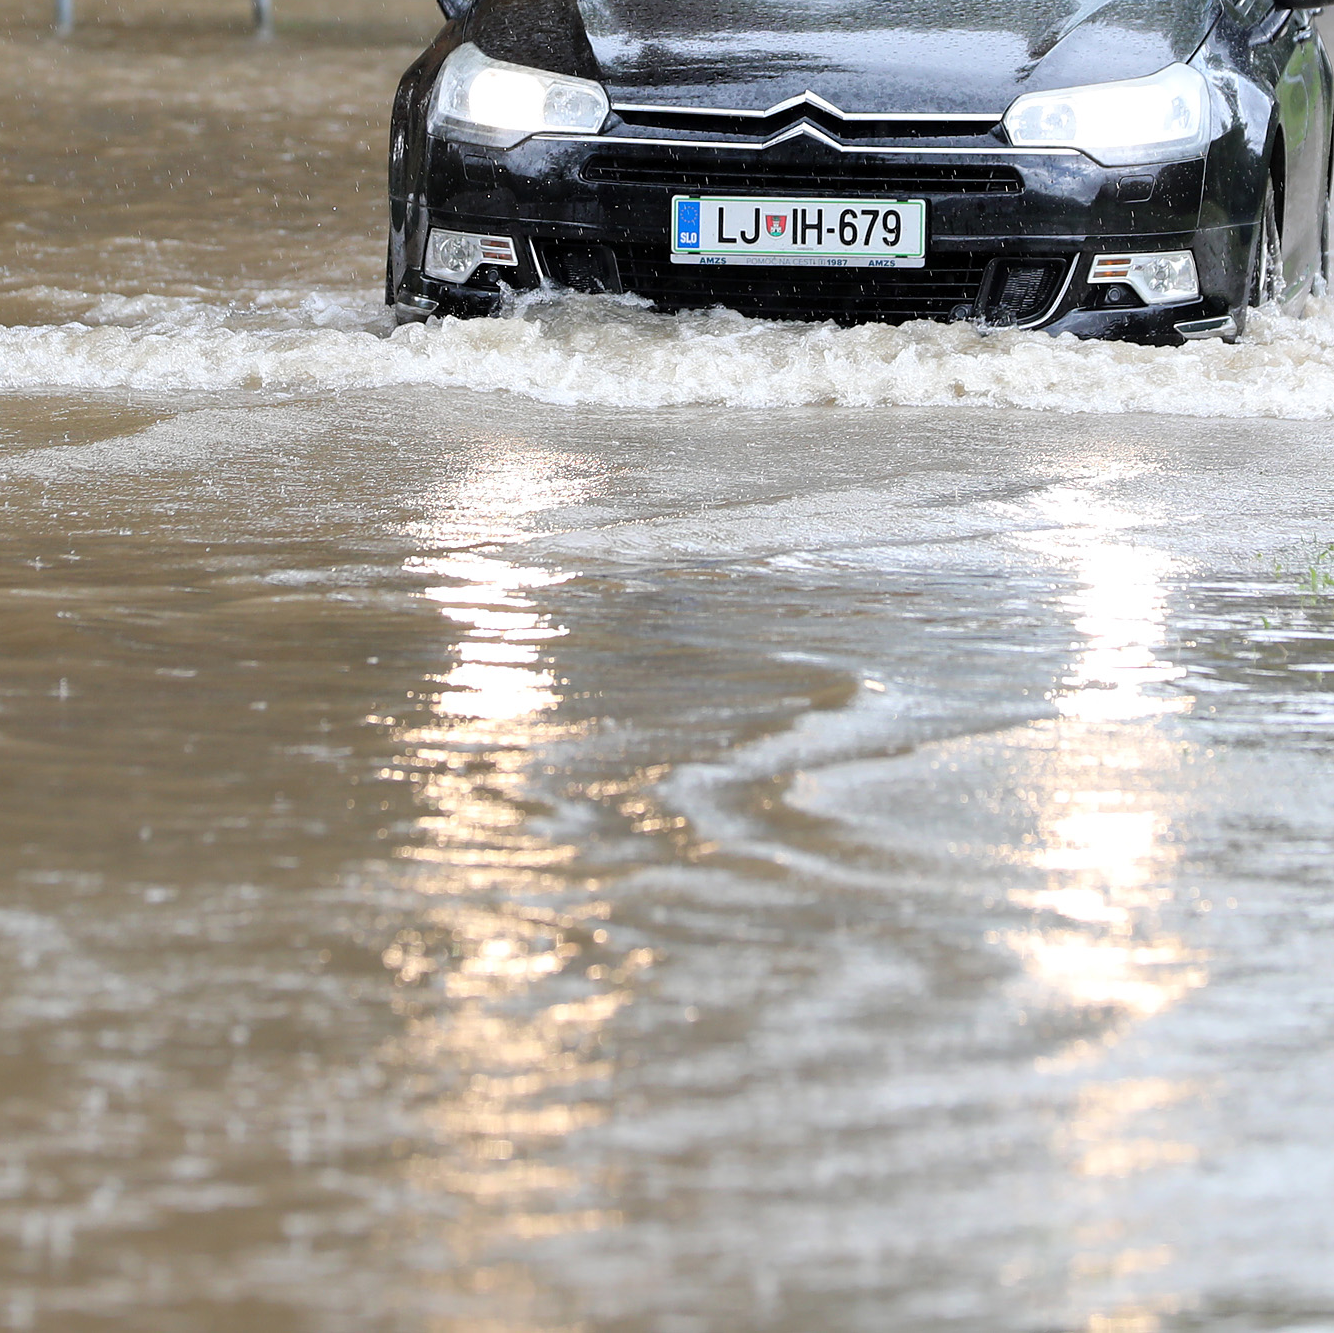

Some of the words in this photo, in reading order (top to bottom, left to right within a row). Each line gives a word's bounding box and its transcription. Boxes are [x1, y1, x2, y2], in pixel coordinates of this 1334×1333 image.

[718, 207, 760, 244] LJ
[792, 208, 901, 246] IH-679
[680, 232, 697, 243] SLO
[699, 257, 727, 265] AMZS
[779, 258, 790, 266] NA
[827, 258, 848, 266] 1987
[868, 259, 896, 267] AMZS
